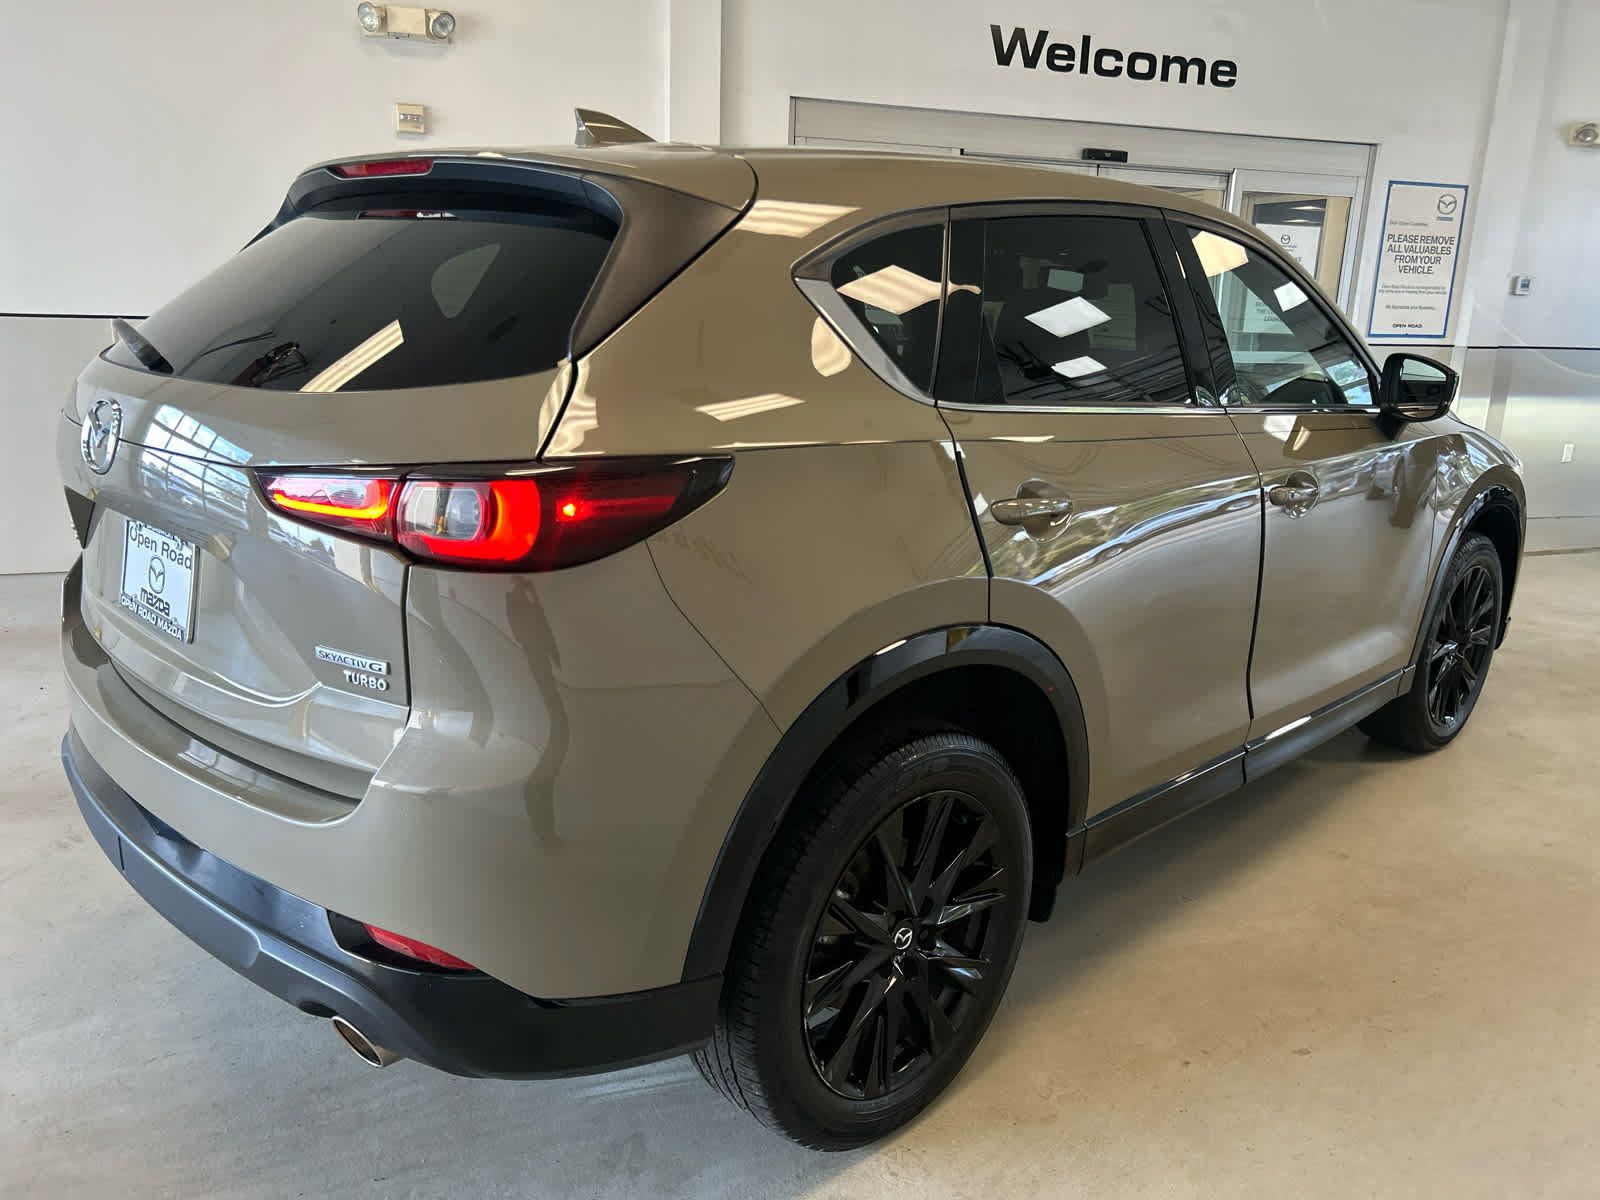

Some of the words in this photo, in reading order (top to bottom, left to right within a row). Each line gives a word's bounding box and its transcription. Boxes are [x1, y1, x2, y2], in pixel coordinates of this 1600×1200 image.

[990, 24, 1238, 88] Welcome
[1387, 233, 1419, 245] PLEASE
[1419, 235, 1456, 246] REMOVE
[1387, 244, 1403, 253] ALL
[1404, 244, 1452, 255] VALUABLES
[1394, 254, 1418, 264] FROM
[1419, 255, 1442, 265] YOUR
[1398, 265, 1434, 275] VEHICLE.
[129, 525, 158, 553] Open
[161, 541, 192, 570] Road
[140, 587, 170, 617] mazda
[157, 618, 183, 640] MAZDA
[343, 669, 387, 691] TURBO
